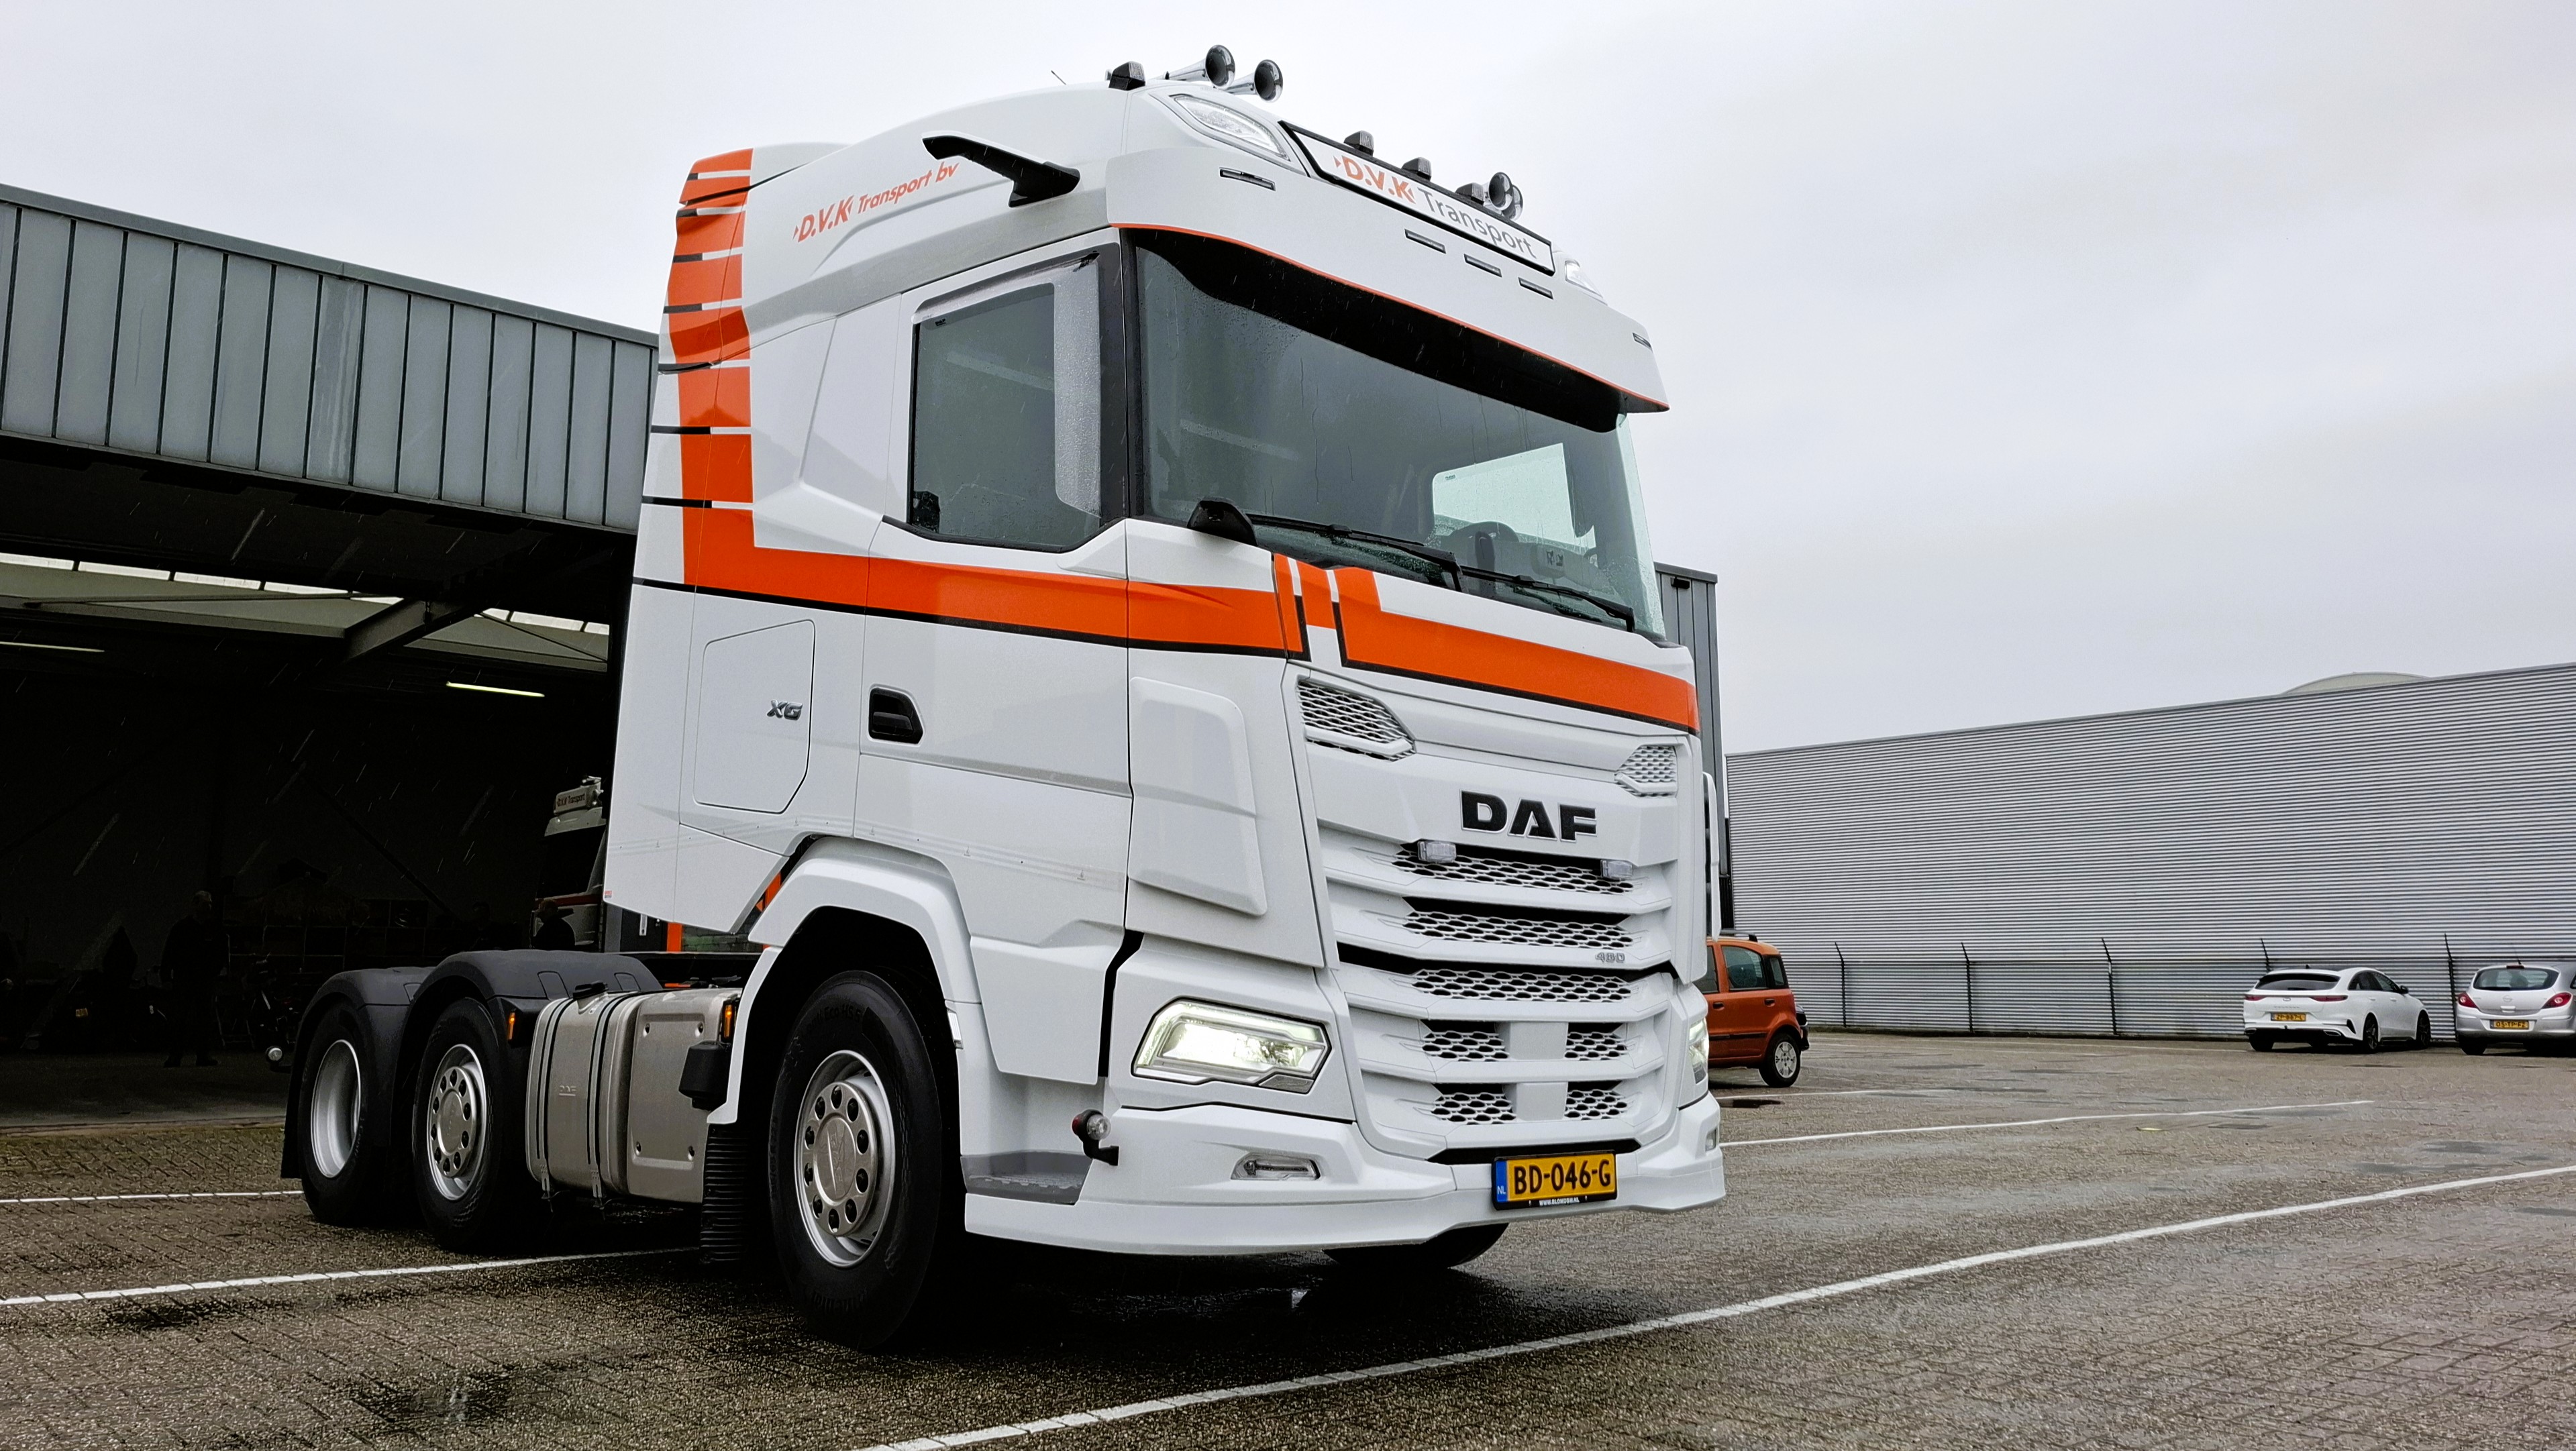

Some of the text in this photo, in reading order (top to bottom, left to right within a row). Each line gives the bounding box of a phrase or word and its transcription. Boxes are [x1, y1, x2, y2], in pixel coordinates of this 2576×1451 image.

[858, 170, 933, 214] Transport
[935, 161, 960, 182] bv
[1417, 186, 1537, 259] Transport
[766, 698, 803, 721] XG
[1459, 789, 1597, 843] DAF
[1595, 952, 1626, 963] 480
[1497, 1159, 1611, 1195] NL BD-046-G
